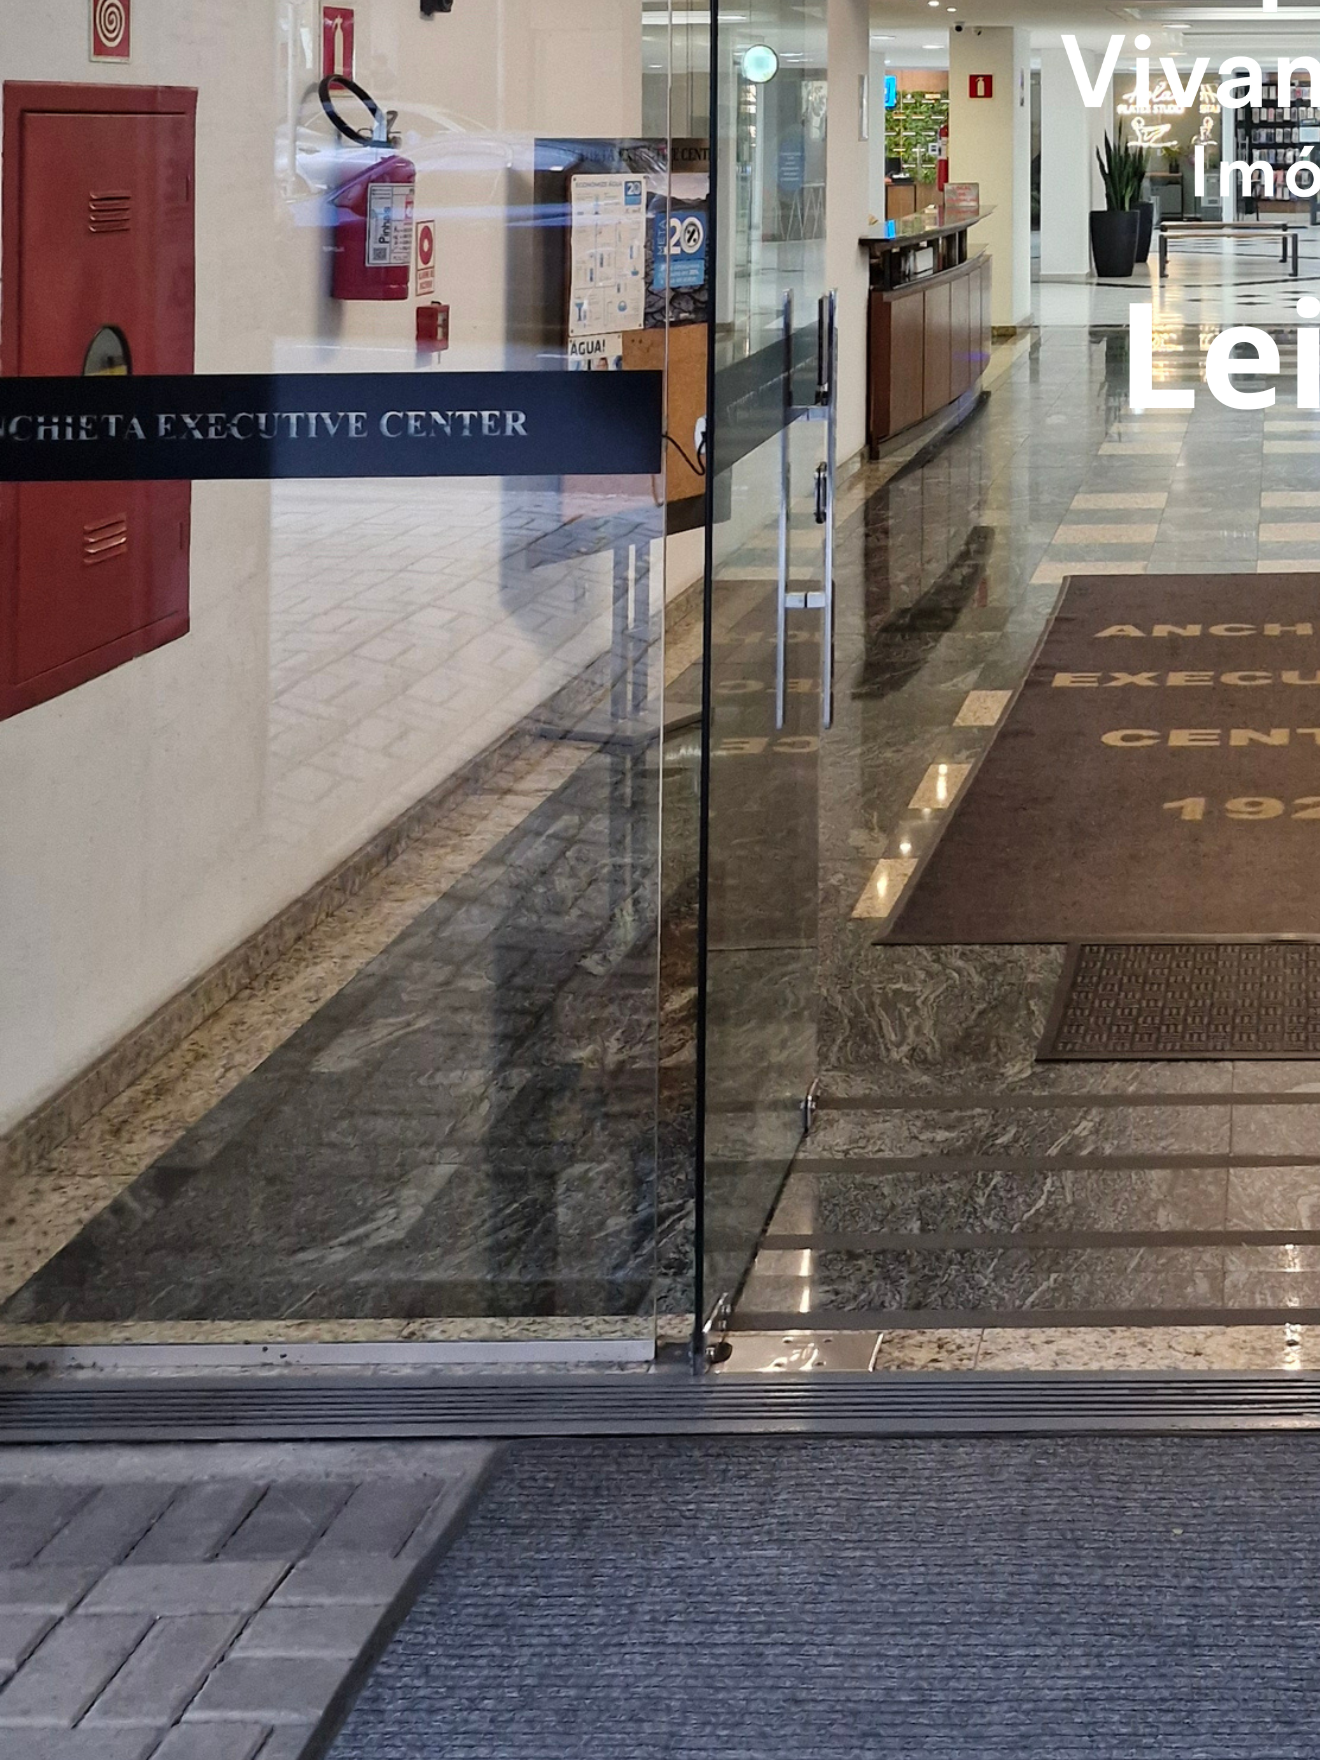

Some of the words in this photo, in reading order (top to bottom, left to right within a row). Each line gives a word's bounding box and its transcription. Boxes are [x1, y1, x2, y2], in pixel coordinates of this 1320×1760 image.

[0, 414, 146, 441] CHIETA
[157, 411, 367, 440] EXECUTIVE
[379, 410, 528, 438] CENTER
